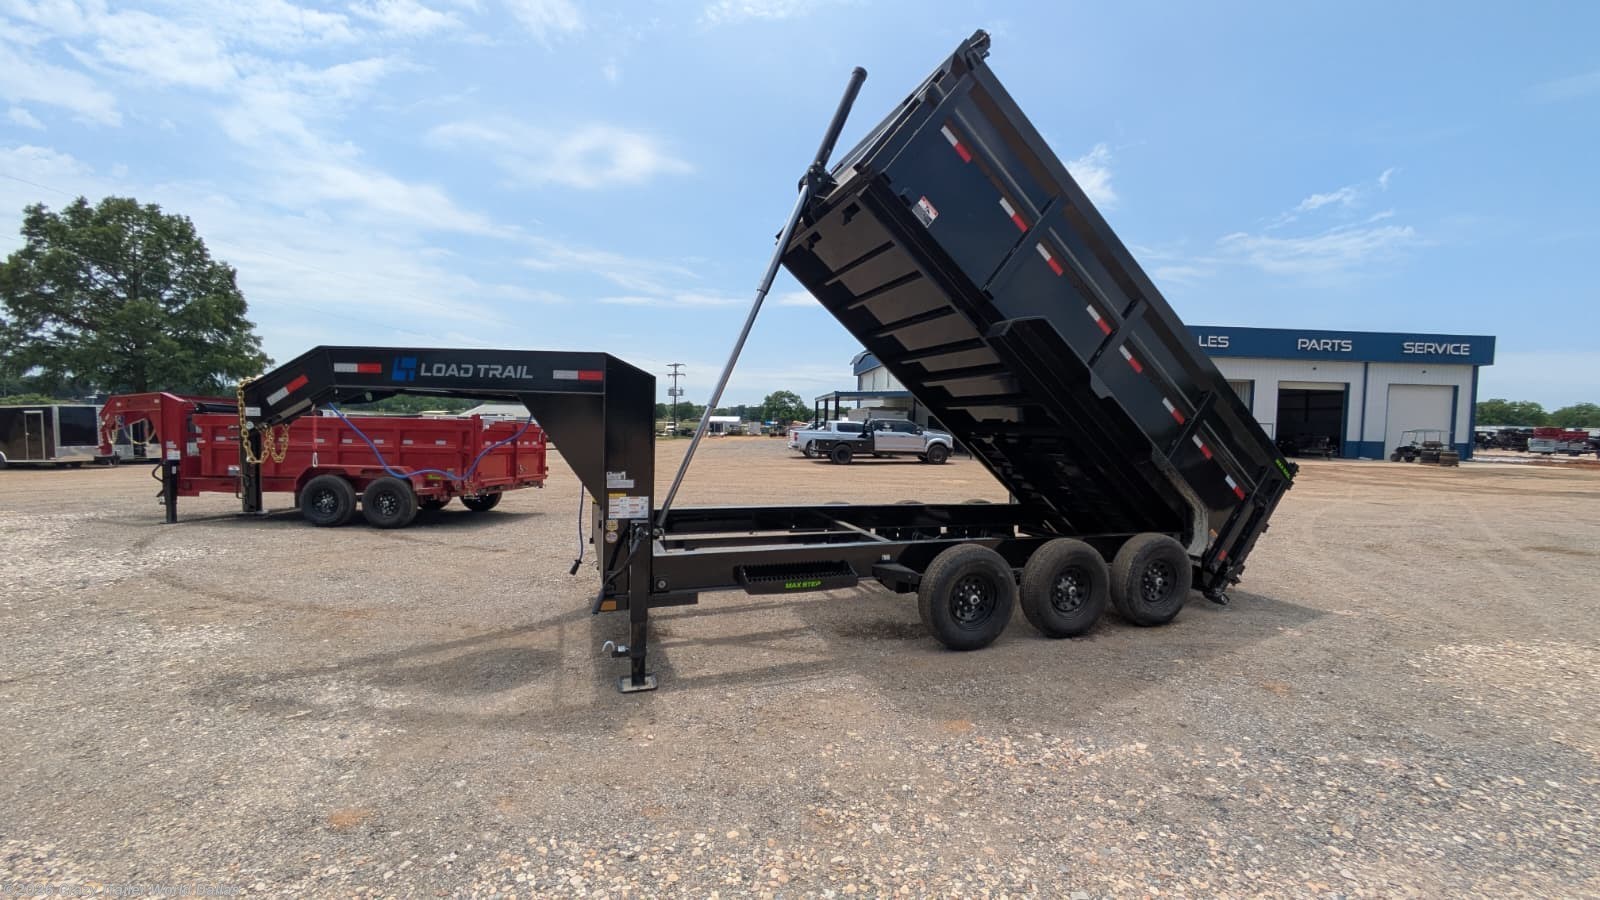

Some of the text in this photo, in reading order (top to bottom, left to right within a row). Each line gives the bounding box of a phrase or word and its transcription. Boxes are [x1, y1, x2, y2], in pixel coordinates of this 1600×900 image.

[1198, 335, 1230, 348] LES
[1297, 338, 1353, 352] PARTS
[1403, 341, 1471, 356] SERVICE
[420, 362, 474, 378] LOAD
[477, 364, 534, 379] TRAIL
[785, 580, 802, 589] MAX
